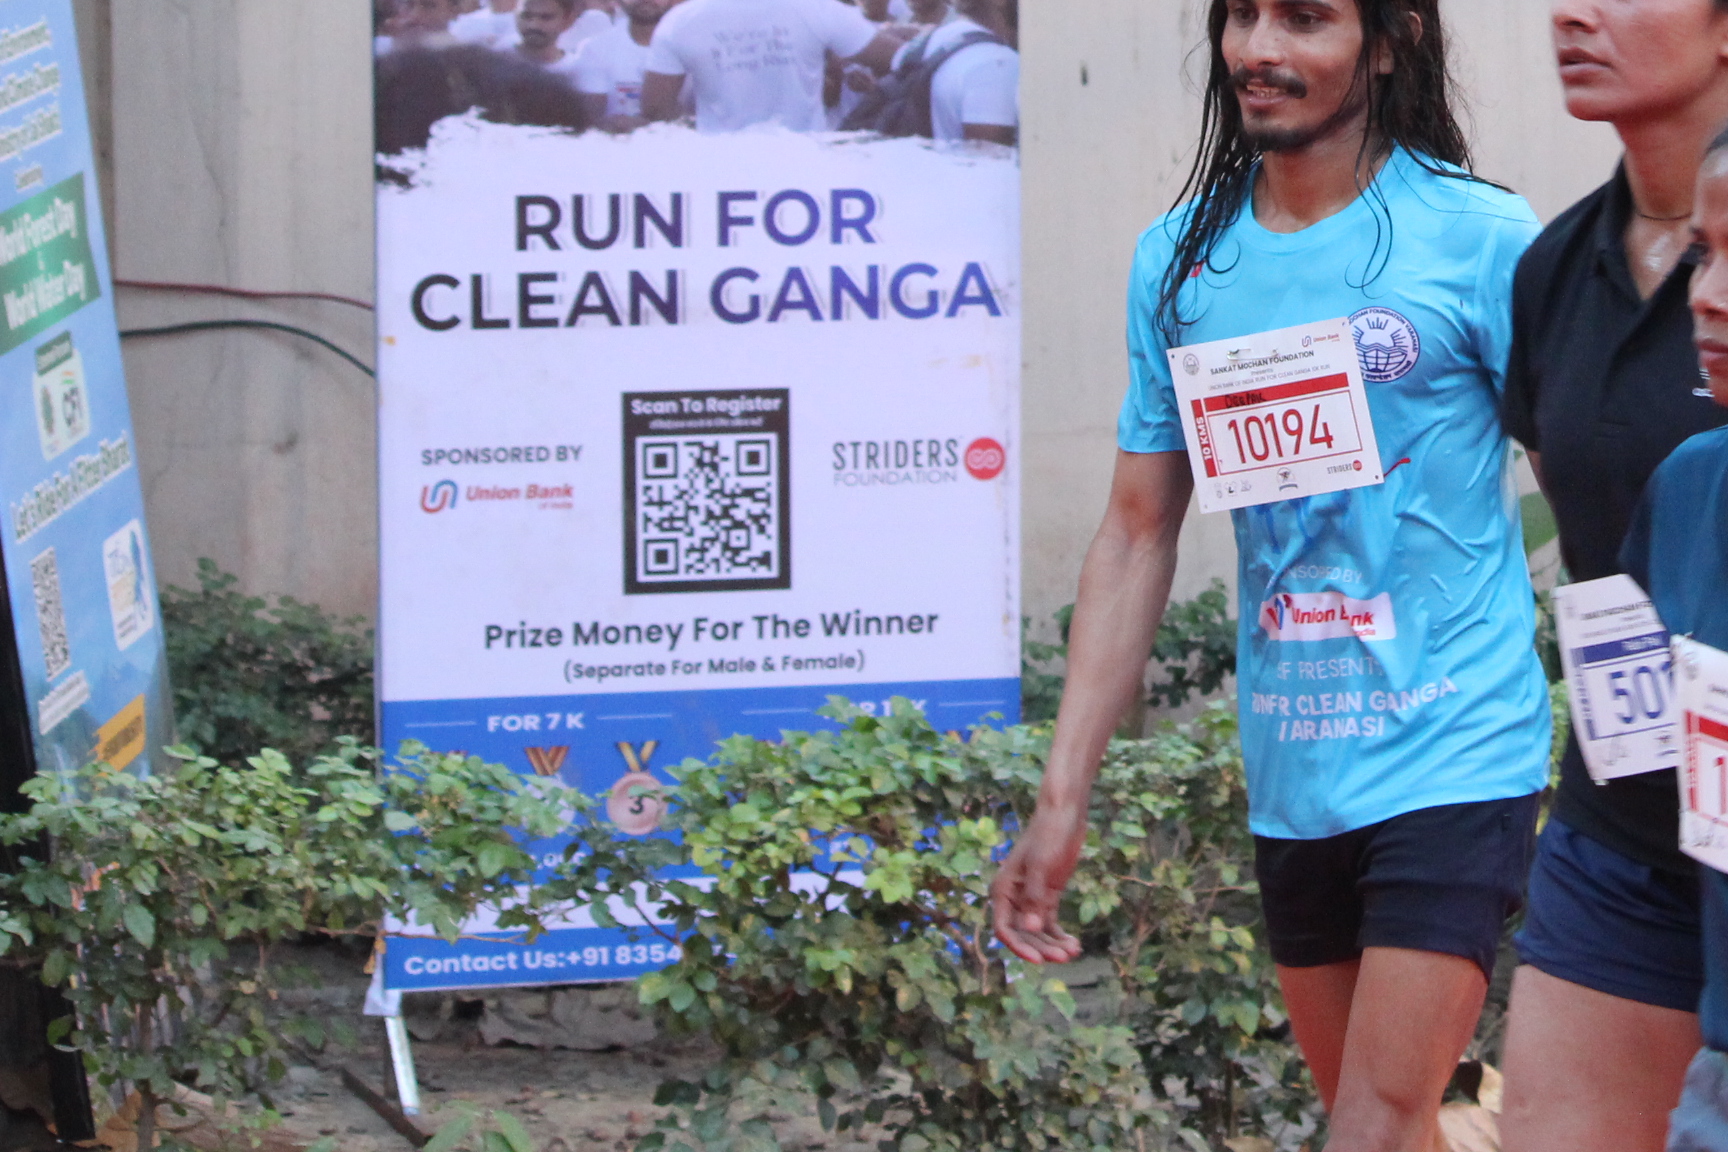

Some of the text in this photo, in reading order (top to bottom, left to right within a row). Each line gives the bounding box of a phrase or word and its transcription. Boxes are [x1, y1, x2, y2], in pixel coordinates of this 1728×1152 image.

[513, 188, 878, 252] RUN FOR
[411, 260, 1003, 332] CLEAN GANGA
[1210, 349, 1314, 376] SANKAT MOCHAN FOUNDATION
[631, 394, 782, 417] Scan To Register
[1196, 416, 1213, 461] 10 KMS
[1228, 404, 1333, 463] 10194
[421, 444, 583, 466] SPONSORED BY
[832, 437, 959, 472] STRIDERS
[466, 482, 573, 502] Union Bank
[833, 469, 957, 487] FOUNDATION
[484, 610, 939, 652] Prize Money For The Winner
[1292, 608, 1335, 624] Union
[563, 650, 866, 684] (Separate For Male & Female)
[1296, 691, 1362, 716] CLEAN
[1369, 676, 1458, 713] GANGA
[487, 711, 586, 733] FOR 7 K
[404, 950, 518, 978] Contact
